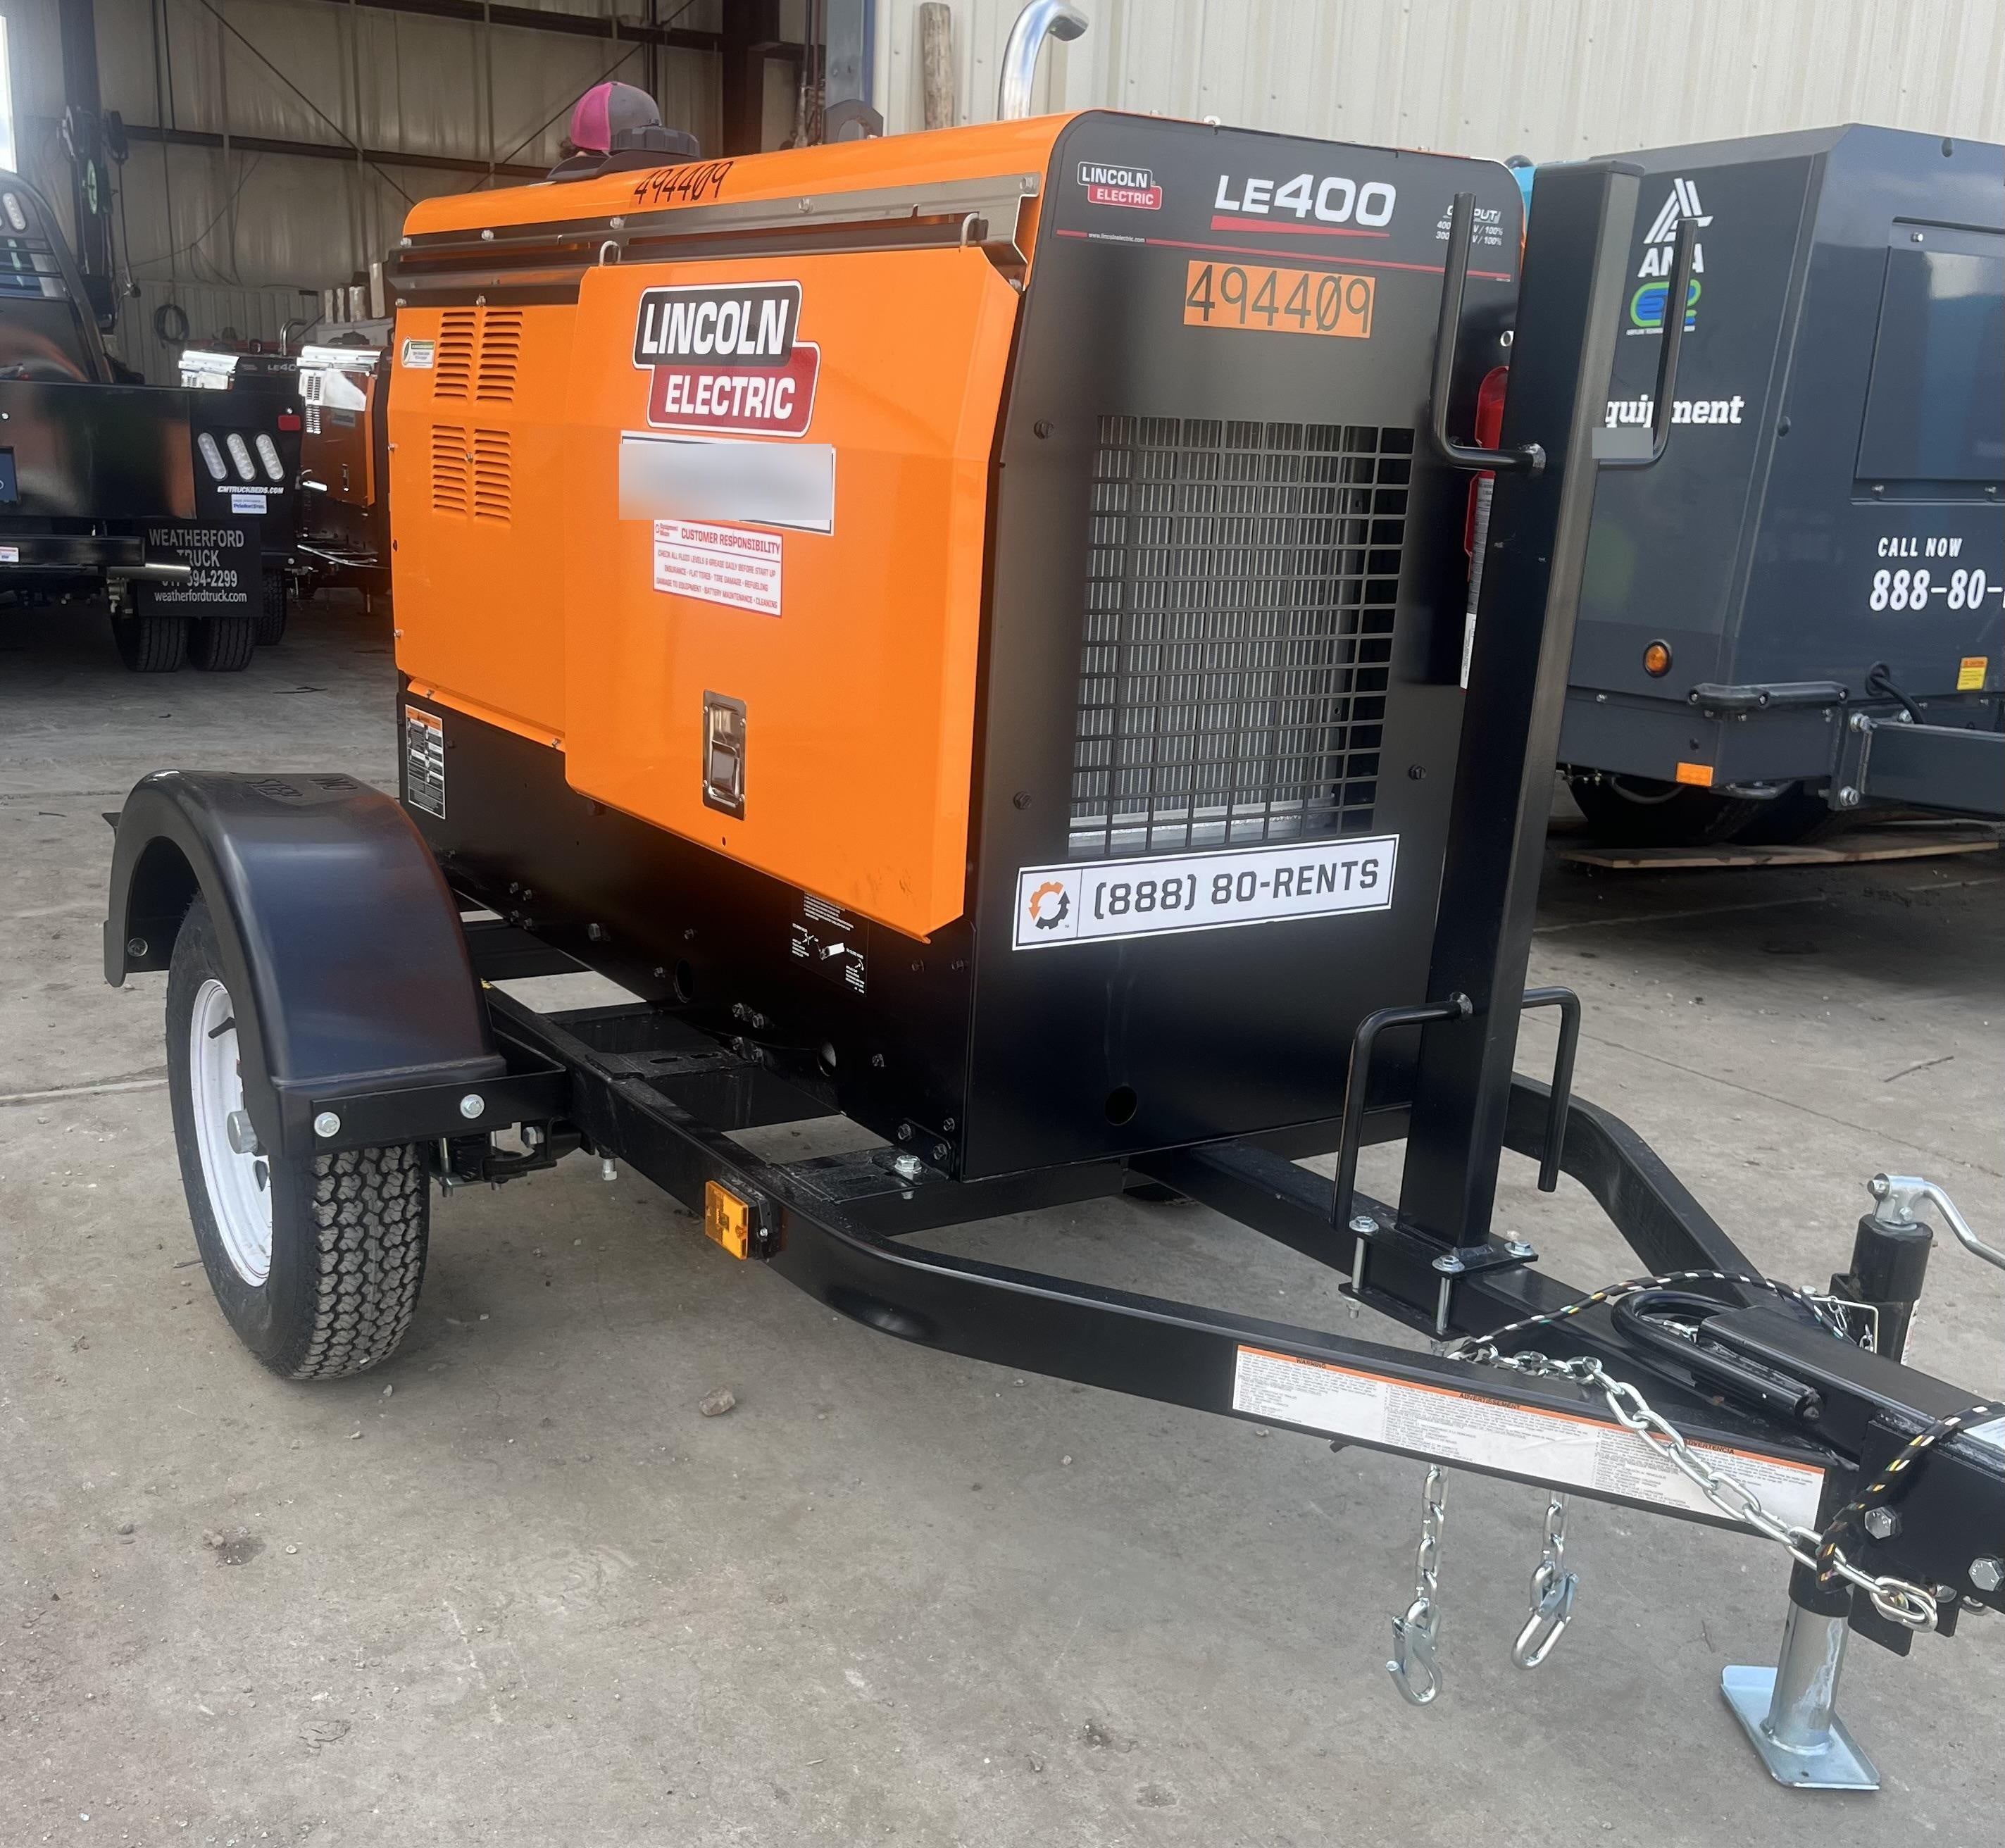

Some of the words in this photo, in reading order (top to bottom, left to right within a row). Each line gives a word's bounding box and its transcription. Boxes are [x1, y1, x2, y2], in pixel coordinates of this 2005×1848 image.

[634, 161, 735, 205] 494409
[1082, 166, 1148, 189] LINCOLN
[1096, 188, 1154, 206] ELECTRIC
[1214, 173, 1397, 227] LE400
[1187, 264, 1370, 334] 494409
[642, 299, 789, 355] LINCOLN
[665, 375, 796, 420] ELECTRIC
[149, 528, 244, 548] WEATHERFORD
[681, 527, 718, 544] CUSTOMER
[719, 533, 780, 555] RESPONSIBILITY
[1878, 537, 1918, 558] CALL
[1925, 537, 1963, 558] NOW
[691, 555, 705, 565] LEVELS
[725, 561, 737, 570] DAILY
[738, 563, 754, 574] BEFORE
[755, 567, 769, 577] START
[769, 569, 776, 578] UP
[713, 574, 723, 583] TIRE
[724, 576, 742, 587] DAMAGE
[744, 580, 768, 592] REFUELING
[1869, 568, 2005, 611] 888-80-
[154, 589, 247, 603] weatherfordtruck.com
[704, 587, 721, 597] BATTERY
[722, 590, 753, 604] MAINTENANCE
[756, 597, 778, 608] CLEANING
[1094, 873, 1197, 920] (888)
[1211, 858, 1379, 905] 80-RENTS
[1296, 1357, 1326, 1369] WARNING
